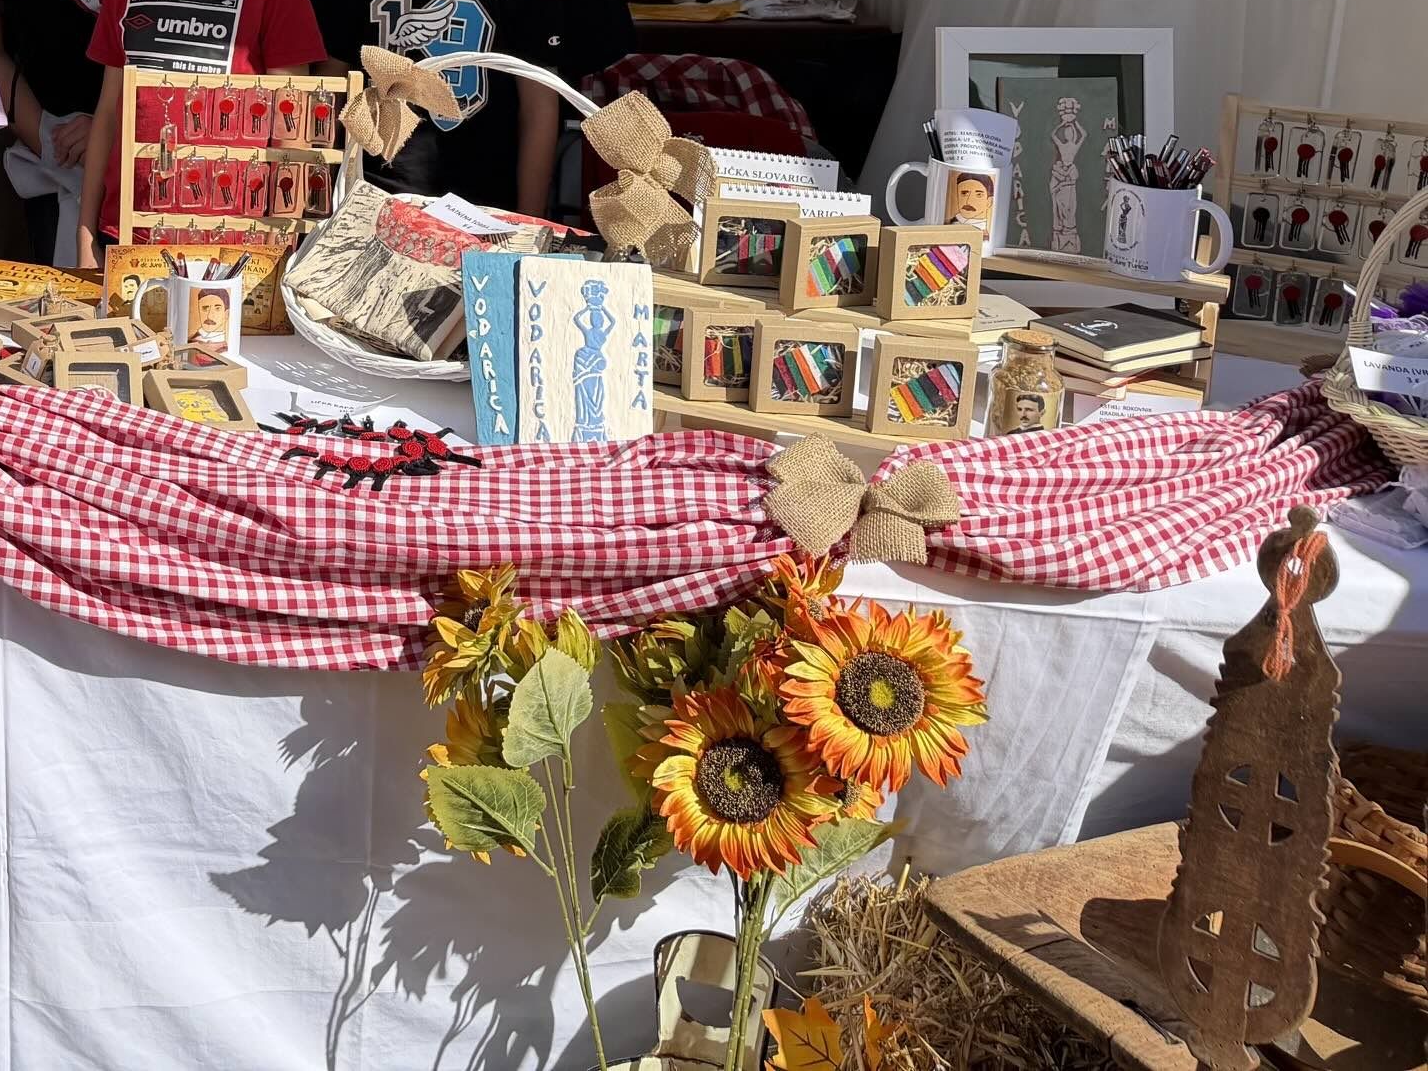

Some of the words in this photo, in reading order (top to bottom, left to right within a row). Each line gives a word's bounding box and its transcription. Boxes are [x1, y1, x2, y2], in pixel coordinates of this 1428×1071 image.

[156, 17, 228, 39] umbro
[172, 61, 187, 71] this
[187, 62, 196, 71] is
[716, 166, 749, 178] LIČKA
[752, 170, 815, 185] SLOVARICA
[527, 279, 552, 443] VODARICA
[631, 303, 650, 411] MARTA
[1363, 360, 1410, 374] LAVANDA
